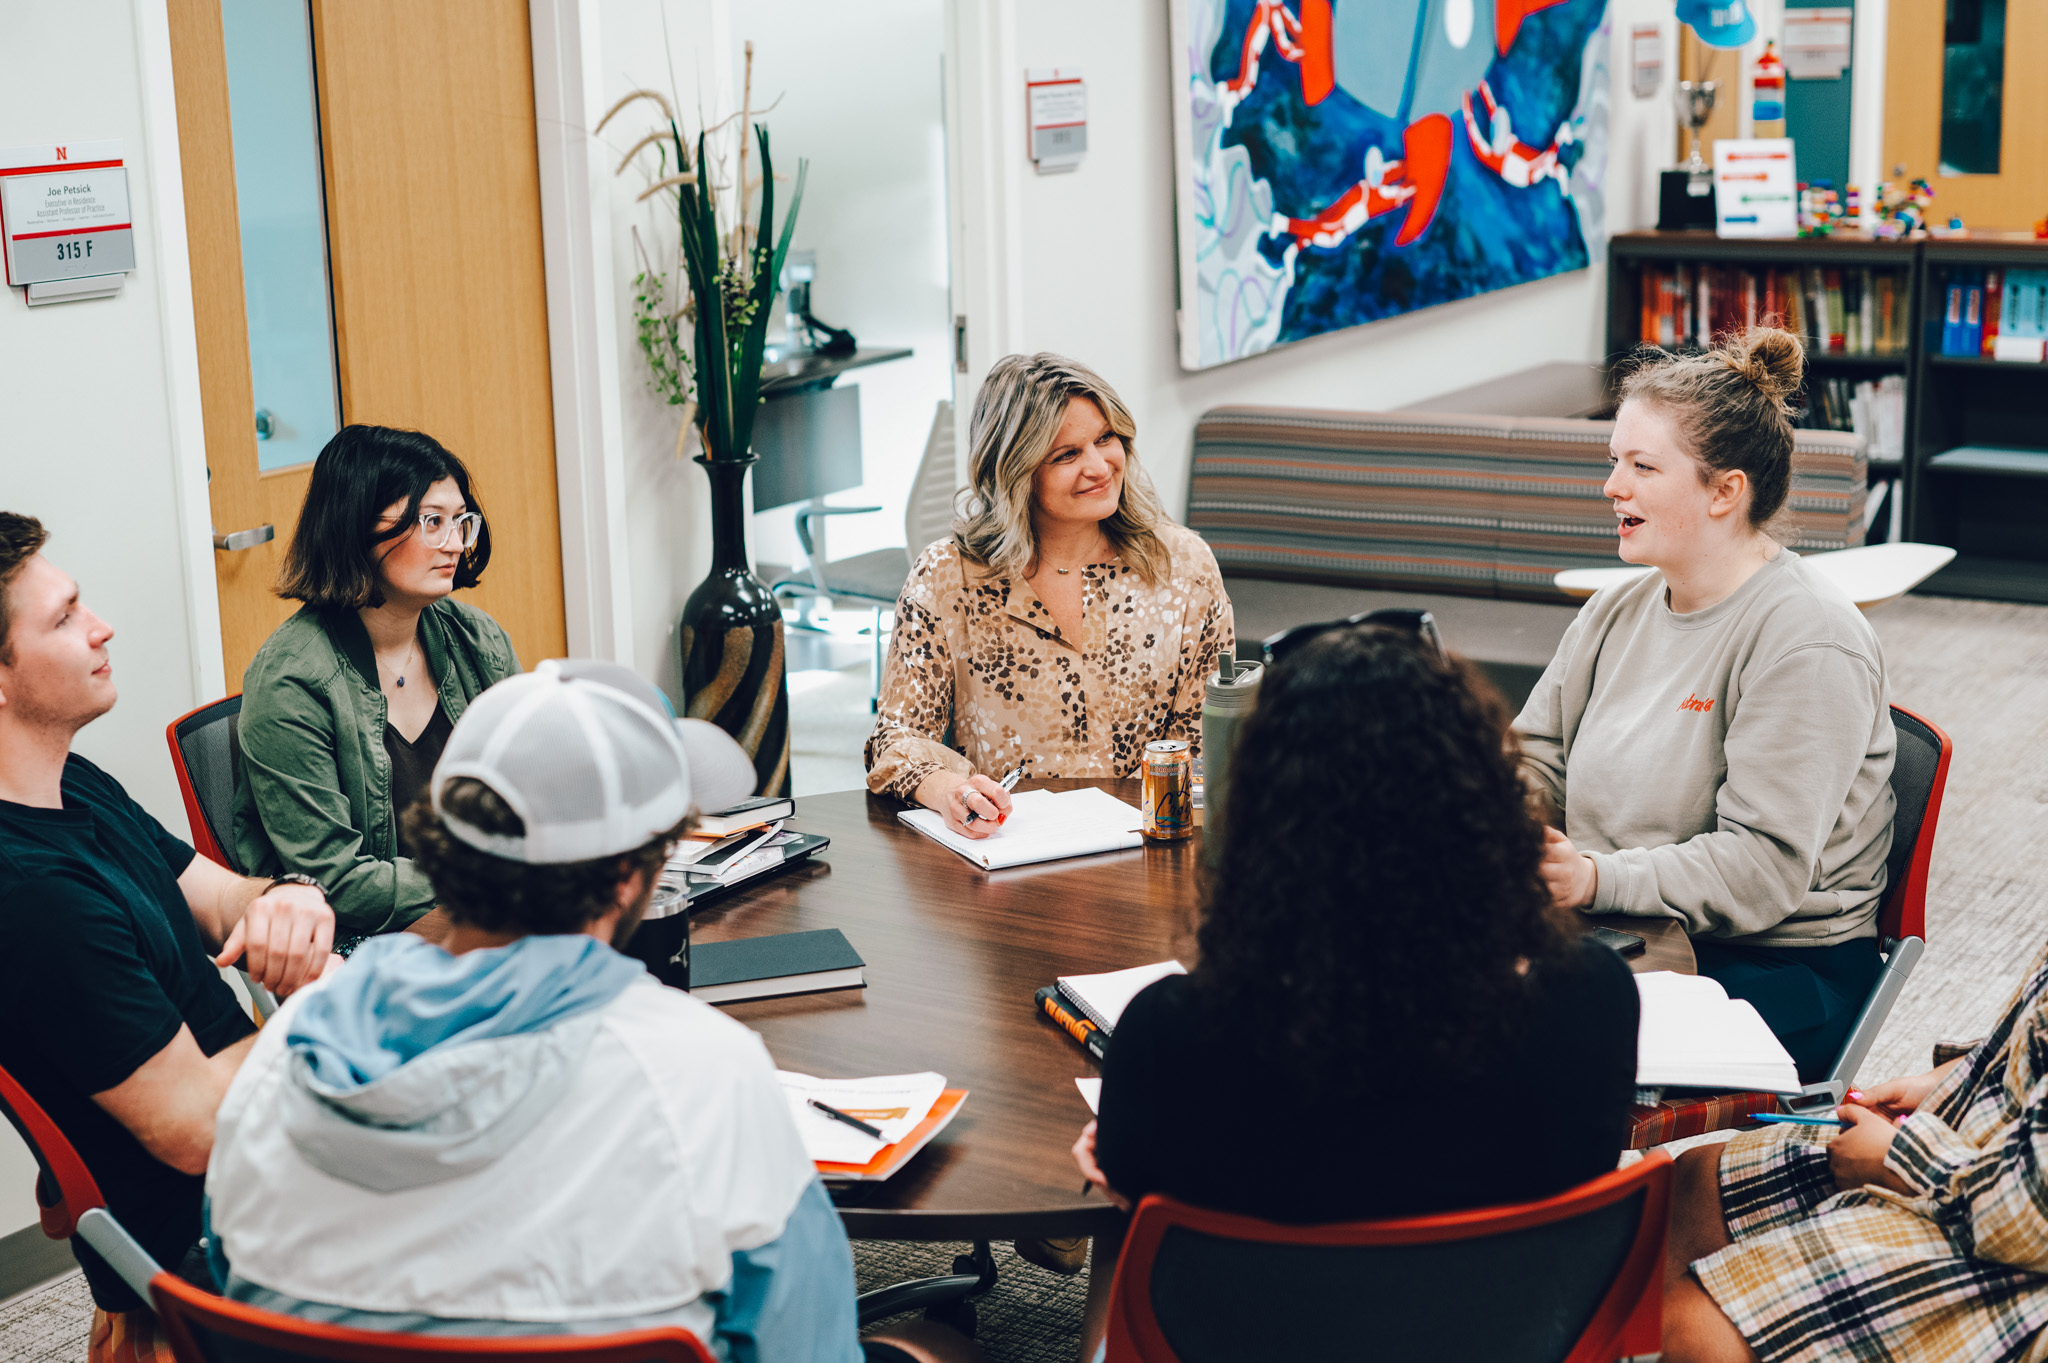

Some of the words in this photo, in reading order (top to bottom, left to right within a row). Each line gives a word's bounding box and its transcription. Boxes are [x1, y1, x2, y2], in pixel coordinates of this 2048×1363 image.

[56, 147, 67, 160] N
[47, 187, 62, 196] Joe
[63, 184, 91, 194] Petsick
[45, 199, 67, 208] Executive
[73, 197, 96, 205] Residence
[36, 208, 59, 217] Assistant
[59, 206, 81, 215] Professor
[87, 204, 105, 212] Practice
[57, 242, 81, 260] 315
[86, 240, 93, 257] F
